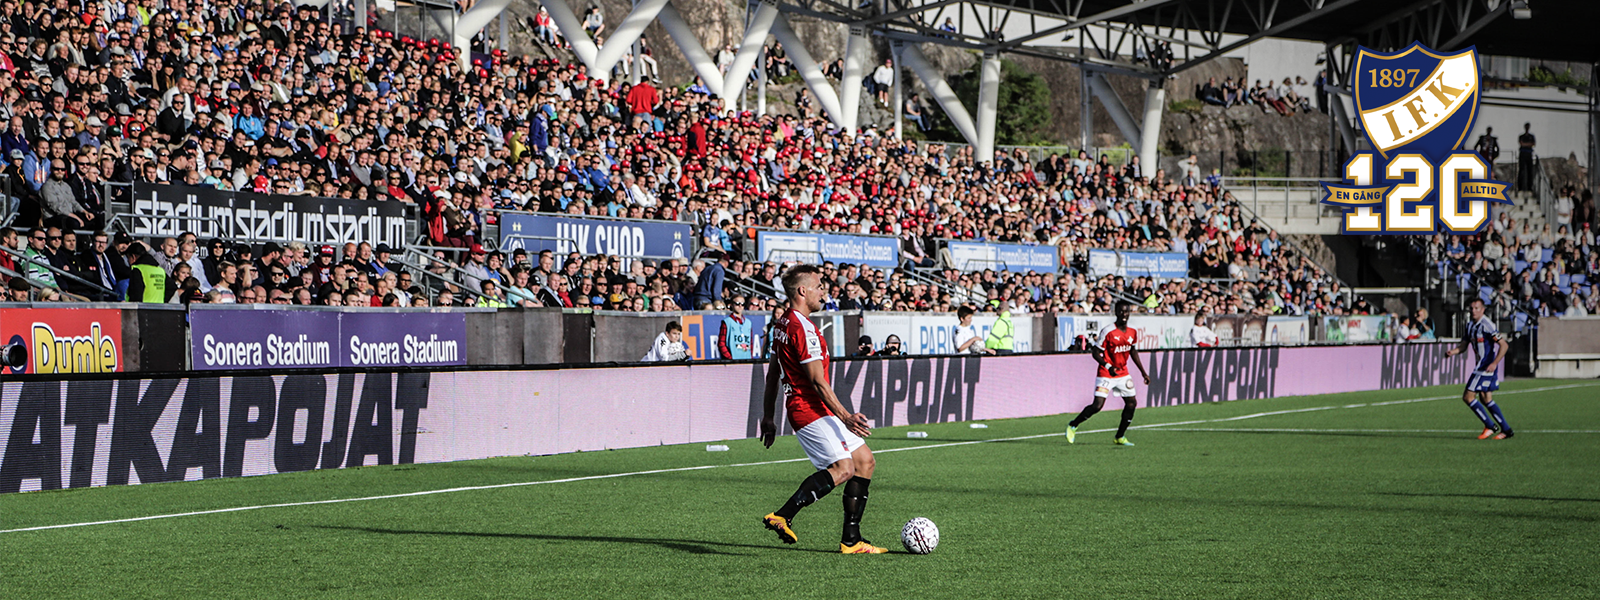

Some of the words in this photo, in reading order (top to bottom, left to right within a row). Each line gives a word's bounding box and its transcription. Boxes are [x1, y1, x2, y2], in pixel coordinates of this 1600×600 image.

[32, 322, 118, 374] Dumle
[203, 333, 262, 366] Sonera
[266, 333, 330, 366] Stadium
[350, 334, 400, 365] Sonera
[403, 333, 458, 364] Stadium
[1380, 342, 1469, 391] MATKAPOJAT
[1146, 347, 1280, 408] MATKAPOJAT
[0, 372, 430, 493] ATKAPOJAT
